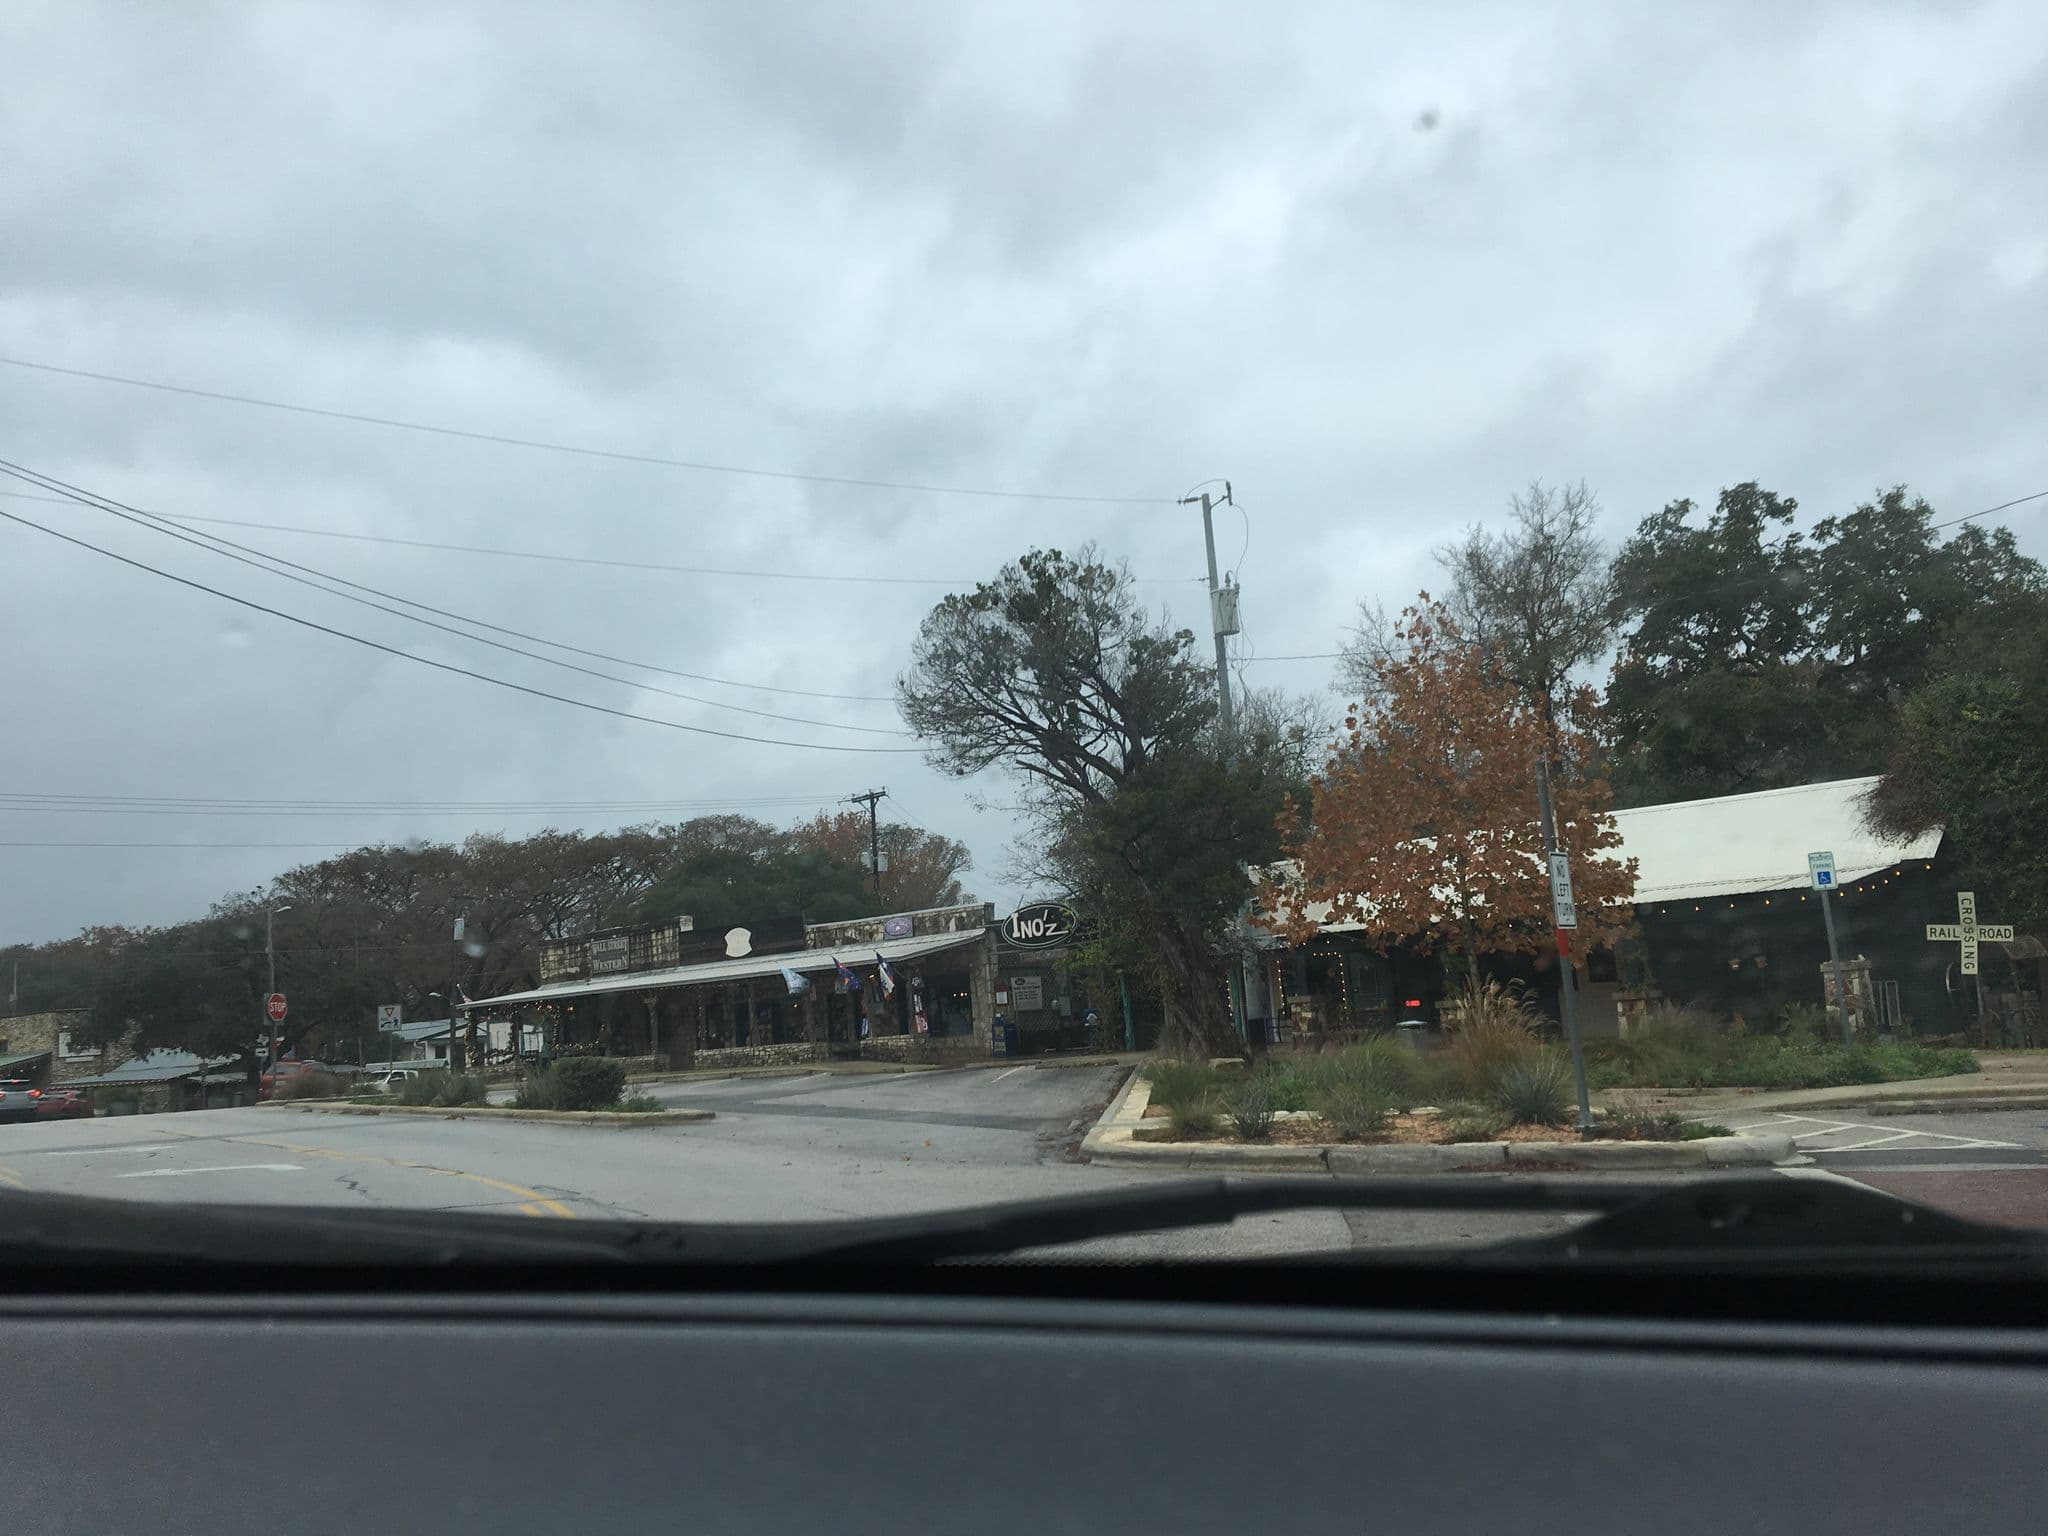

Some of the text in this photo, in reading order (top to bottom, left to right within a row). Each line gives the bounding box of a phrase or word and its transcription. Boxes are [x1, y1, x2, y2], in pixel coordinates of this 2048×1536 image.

[1557, 883, 1569, 897] LEFT
[1929, 928, 2012, 939] RAIL ROAD
[1960, 898, 1975, 969] CROSSING
[592, 955, 628, 970] WESTERN
[270, 1002, 287, 1012] STOP
